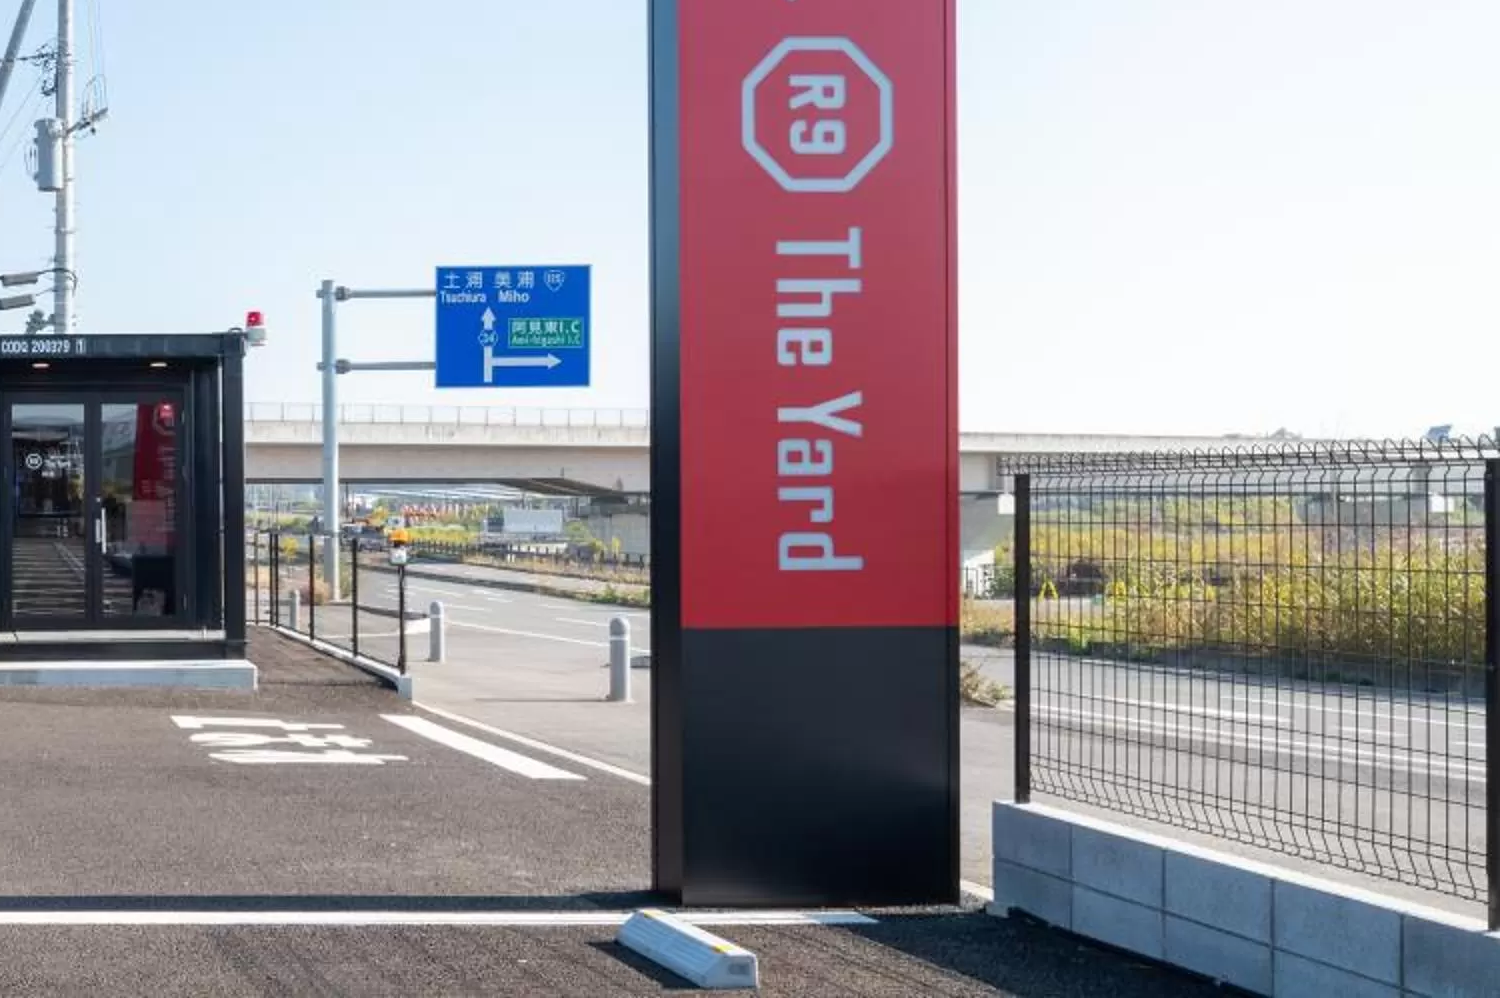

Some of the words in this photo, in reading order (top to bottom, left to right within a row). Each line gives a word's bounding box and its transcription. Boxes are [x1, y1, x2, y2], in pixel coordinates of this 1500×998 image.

[788, 75, 847, 155] R9
[443, 271, 483, 289] 土浦
[498, 289, 530, 303] Miho
[775, 226, 862, 366] The
[776, 391, 864, 571] Yard
